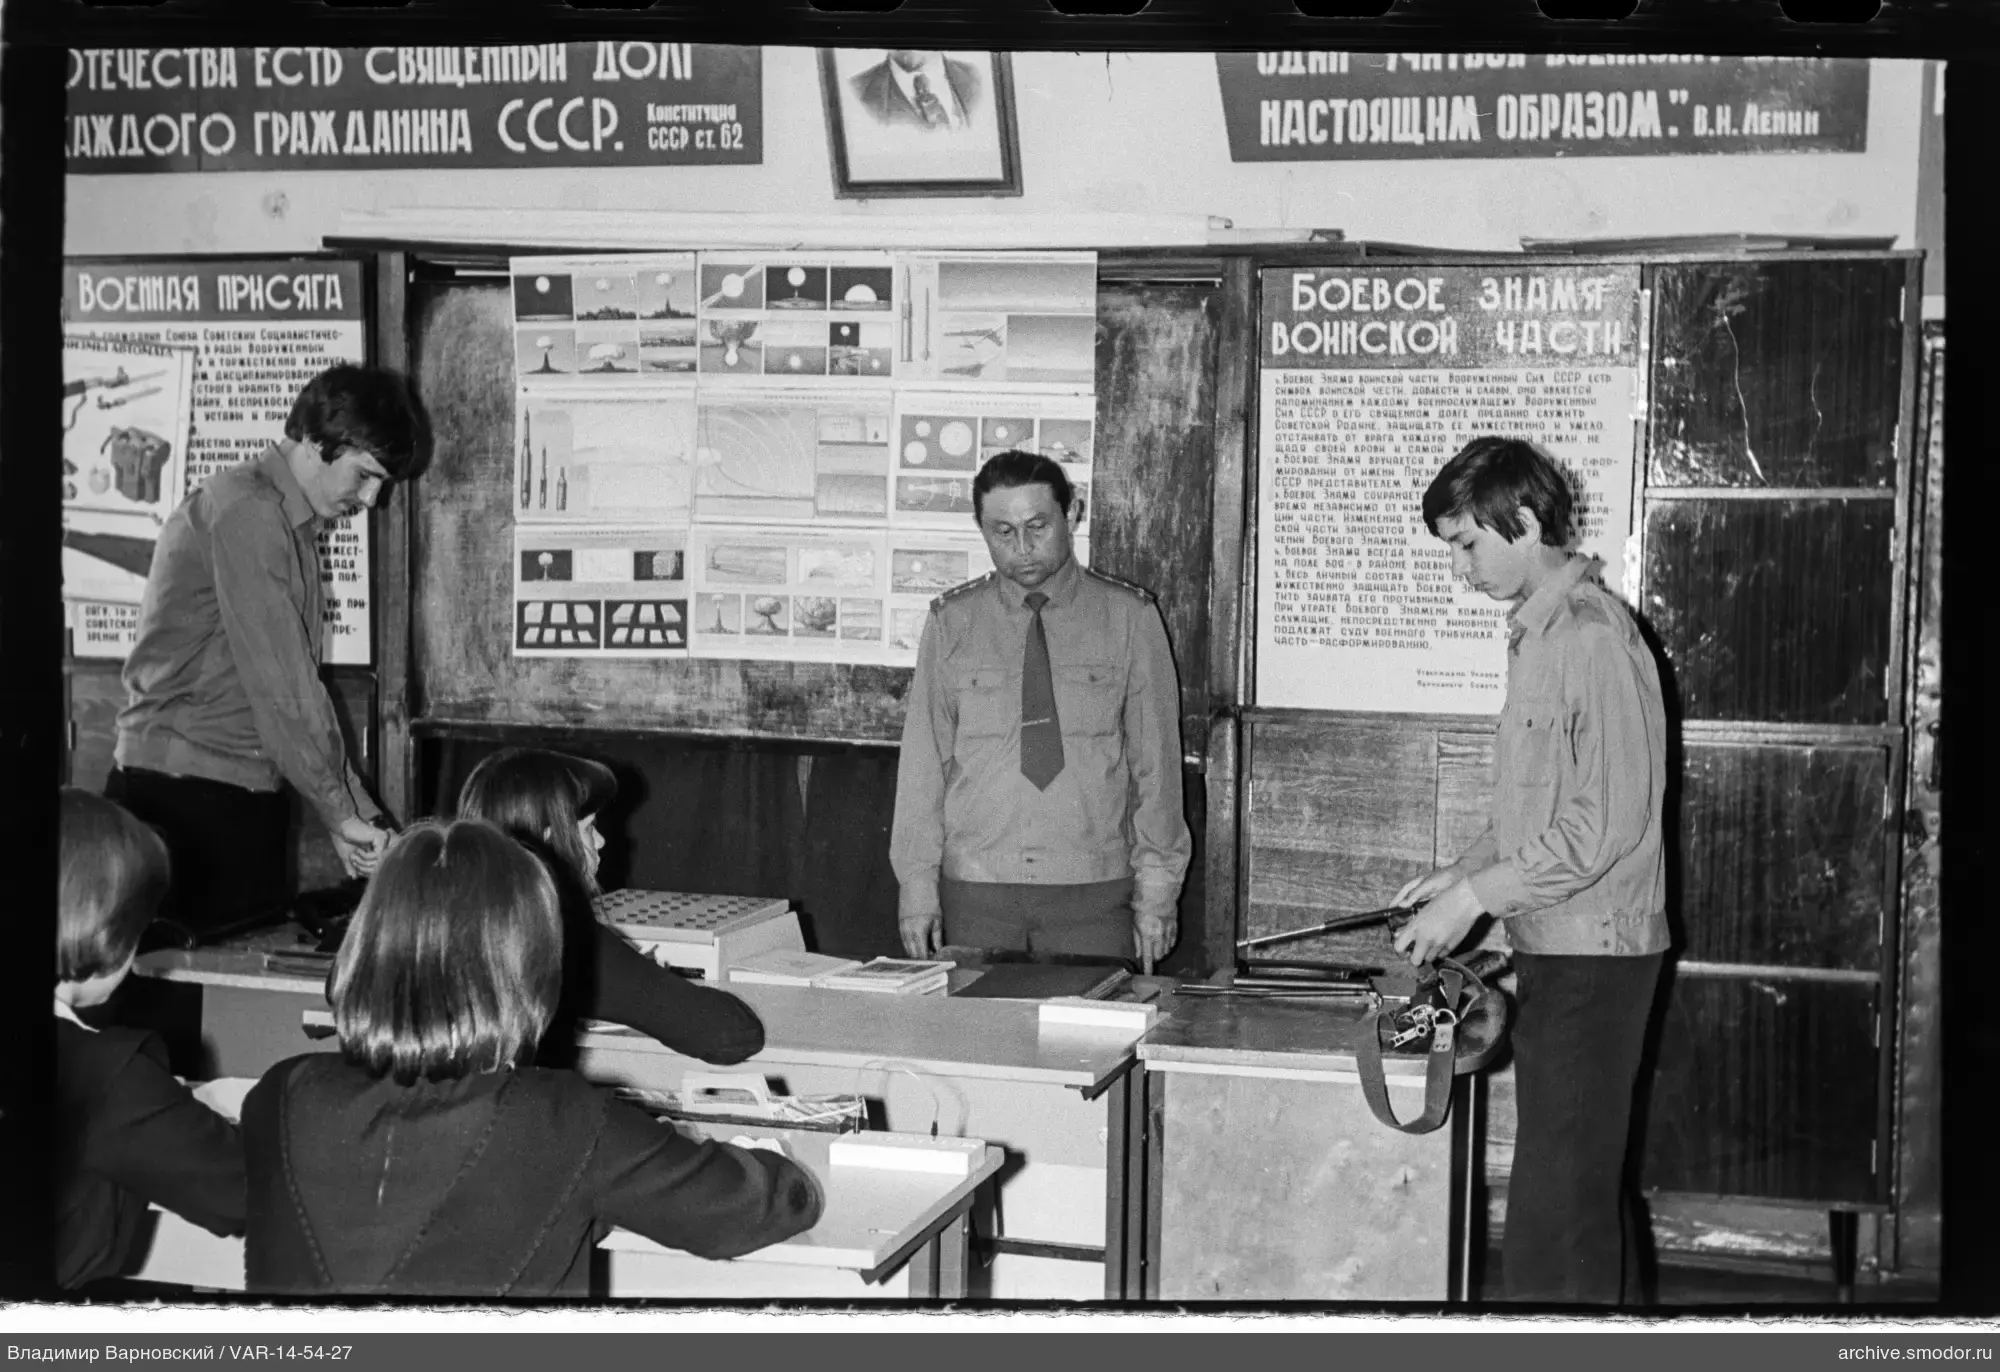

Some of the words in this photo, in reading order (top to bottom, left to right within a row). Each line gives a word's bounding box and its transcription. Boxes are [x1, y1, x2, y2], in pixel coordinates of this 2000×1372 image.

[255, 46, 343, 86] ЕСТЬ
[67, 112, 236, 157] АЖДОГО
[254, 108, 472, 156] ГРАЖДАНИНА
[498, 97, 624, 153] СССР.
[648, 126, 689, 149] СССР
[720, 122, 744, 149] 62
[1260, 95, 1481, 146] НАСТОЯЩИМ
[78, 273, 200, 312] ВОЕННАЯ
[217, 274, 344, 311] ПРИСЯГА
[1292, 272, 1446, 312] БОЕВОЕ
[1478, 276, 1606, 311] ЗНАМЯ
[1271, 316, 1458, 356] ВОИНСКОЙ
[1496, 319, 1622, 356] ЧАСТИ
[1553, 371, 1583, 384] СССР
[1300, 407, 1328, 420] СССР
[1275, 476, 1302, 488] СССР
